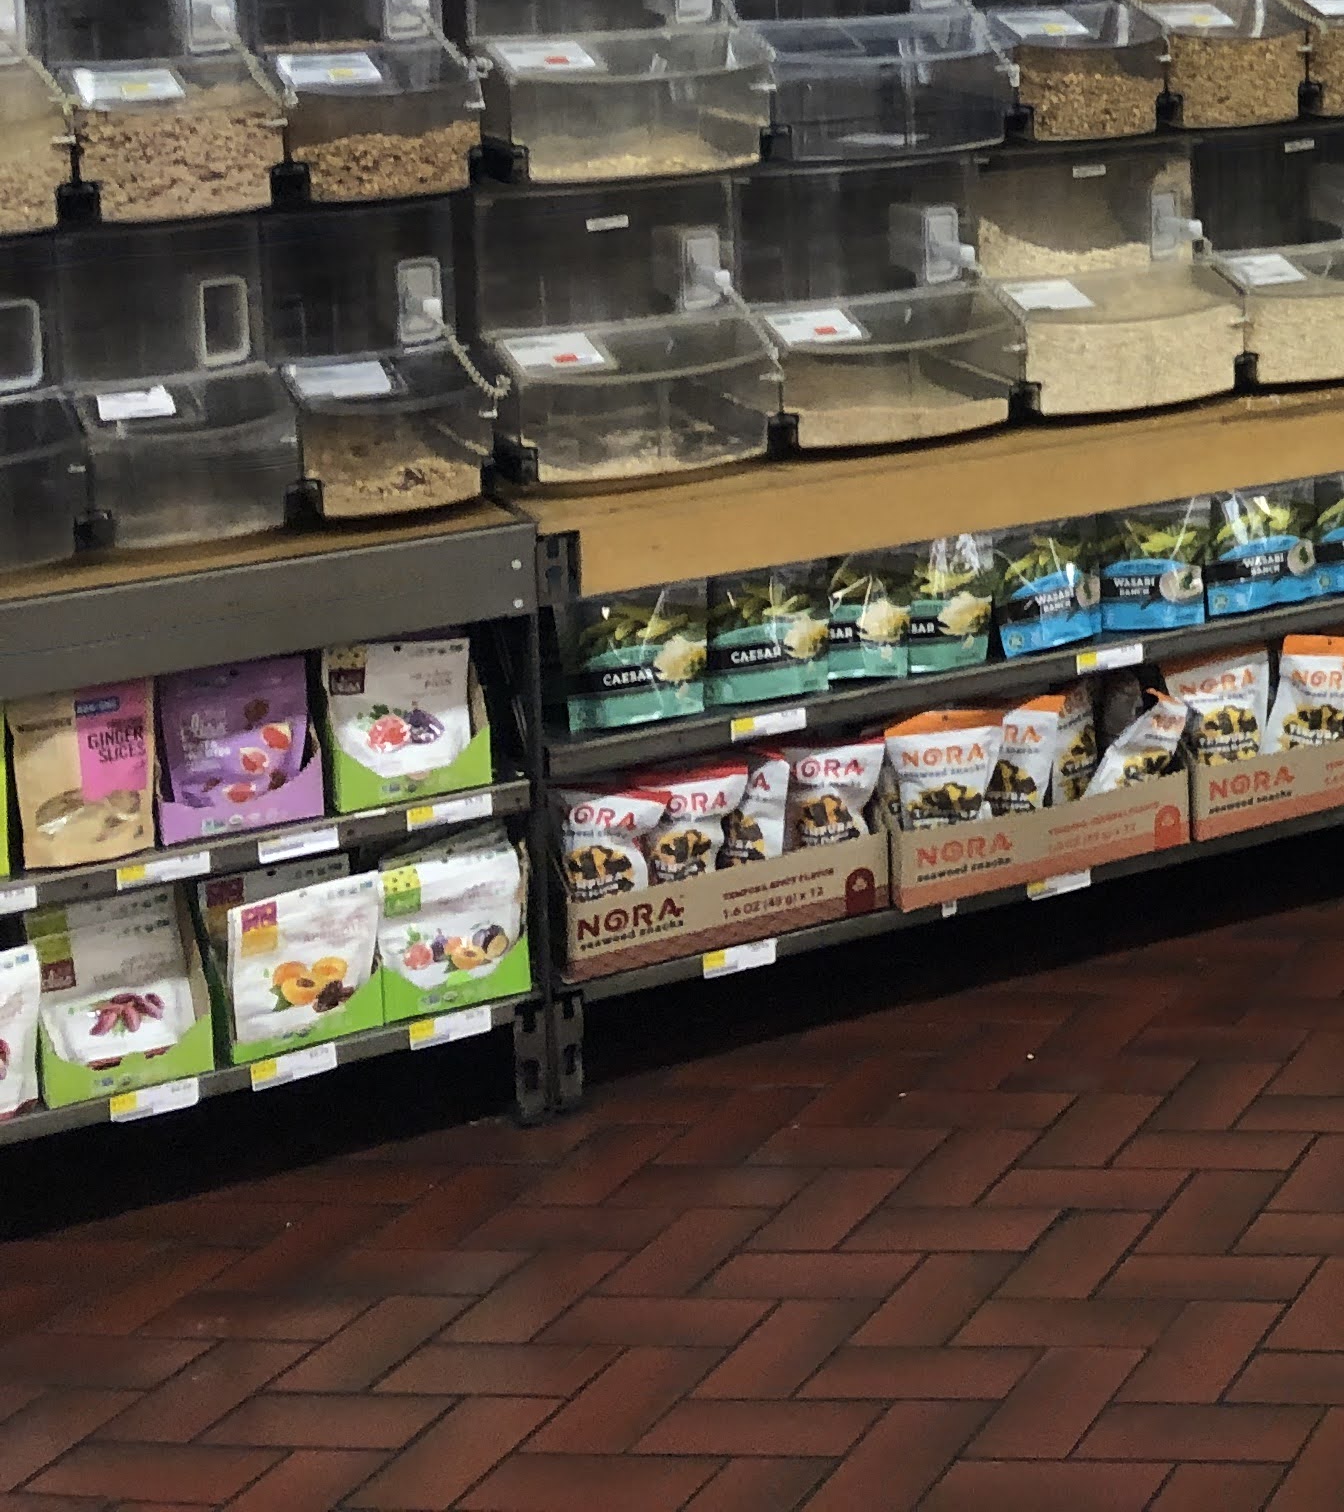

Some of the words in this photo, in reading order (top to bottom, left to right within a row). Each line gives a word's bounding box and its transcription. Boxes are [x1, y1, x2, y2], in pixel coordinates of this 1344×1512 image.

[1242, 552, 1284, 569] WASABI
[1113, 576, 1155, 588] WASABI
[1034, 586, 1075, 606] WASABI
[730, 646, 782, 664] CAESAR
[602, 668, 653, 687] CAESAR
[1179, 668, 1255, 694] NORA
[87, 725, 144, 750] GINGER
[99, 741, 146, 764] SLICES
[901, 742, 985, 768] NORA
[1209, 765, 1296, 803] NORA
[666, 790, 728, 814] ORA
[1208, 797, 1254, 816] seaweed
[1256, 790, 1293, 805] snacks
[573, 804, 637, 832] ORA
[916, 831, 1014, 869] NORA
[917, 864, 968, 883] seaweed
[970, 857, 1012, 873] snacks
[577, 896, 685, 941] NORA
[743, 900, 760, 915] OZ
[580, 929, 636, 952] seaweed
[639, 919, 684, 937] snacks
